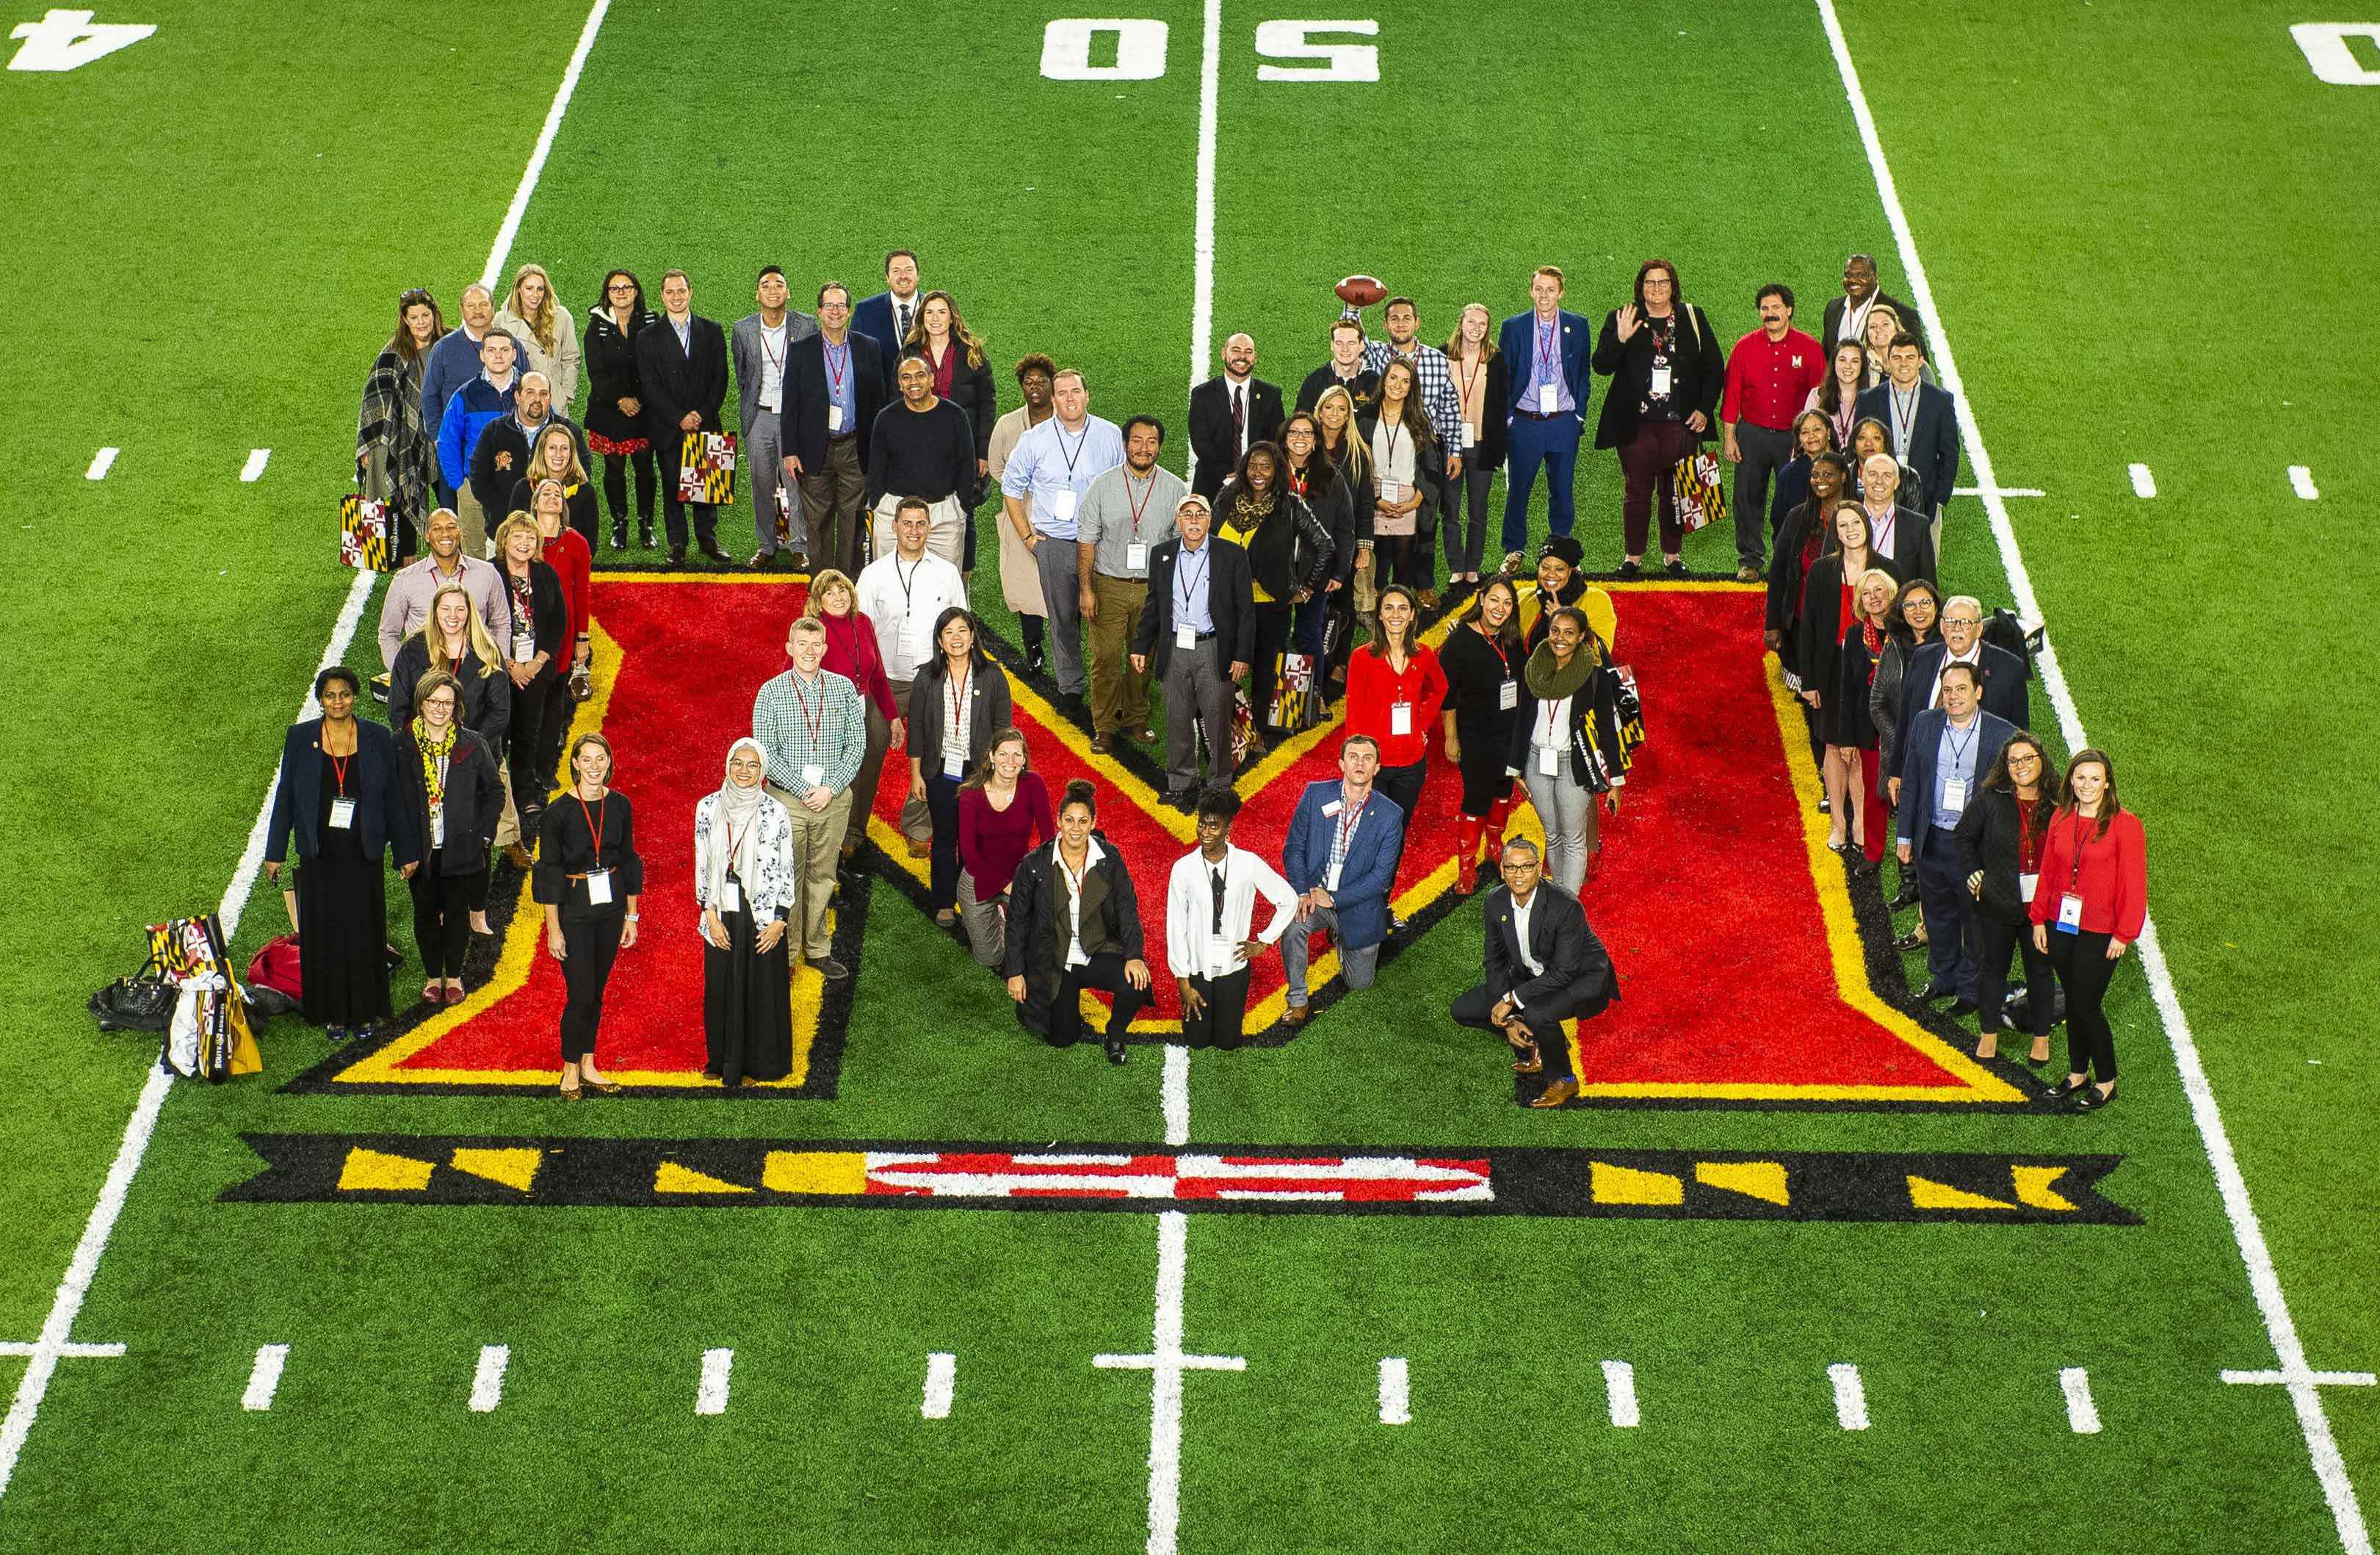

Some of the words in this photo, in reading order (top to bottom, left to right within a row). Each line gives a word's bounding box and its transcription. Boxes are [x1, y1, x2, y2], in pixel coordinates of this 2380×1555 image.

[7, 9, 157, 71] 4
[1792, 355, 1803, 367] M
[214, 1045, 223, 1069] ROUTE
